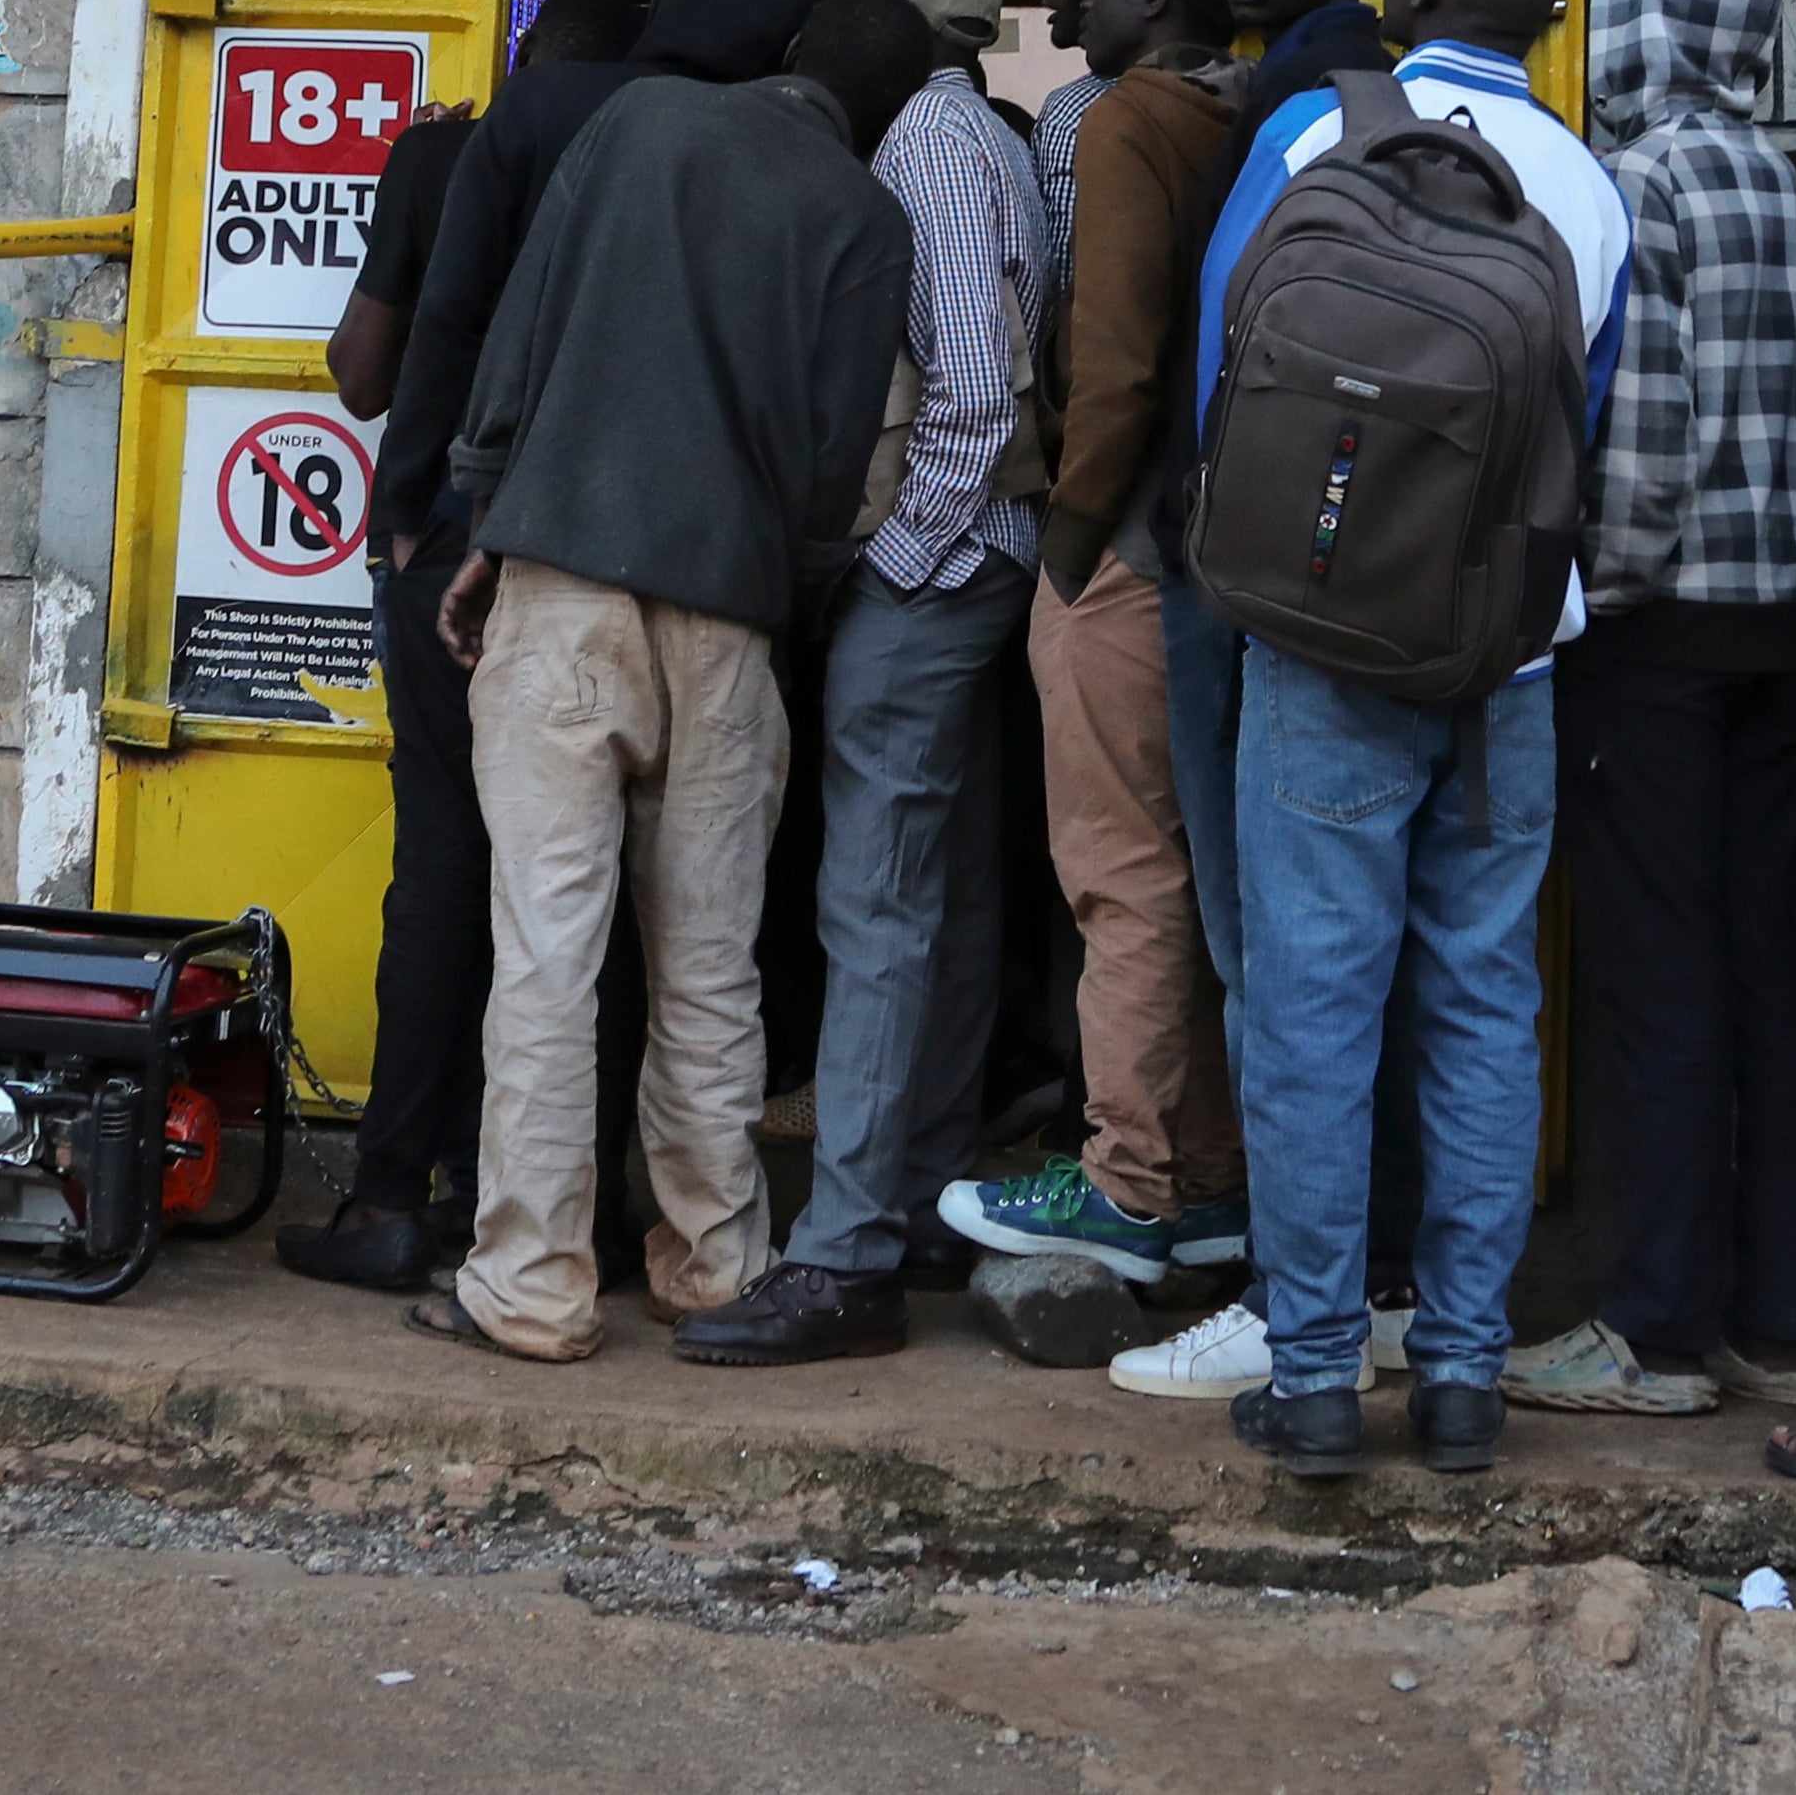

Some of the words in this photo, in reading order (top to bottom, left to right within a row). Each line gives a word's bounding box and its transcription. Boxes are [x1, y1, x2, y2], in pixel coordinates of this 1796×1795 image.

[238, 69, 399, 146] 18+
[217, 179, 376, 216] ADULT
[268, 433, 322, 449] UNDER
[251, 452, 343, 551] 18
[204, 609, 227, 622] This
[229, 611, 258, 625] Shop
[260, 613, 271, 624] Is
[271, 614, 312, 629] Strictly
[313, 617, 372, 631] Prohibited
[191, 627, 210, 639] For
[211, 629, 251, 642] Persons
[253, 631, 285, 644] Under
[286, 634, 307, 645] The
[307, 635, 330, 649] Age
[331, 637, 346, 648] Of
[186, 646, 258, 661] Management
[260, 650, 283, 663] Will
[285, 652, 306, 665] Not
[307, 653, 323, 665] Be
[325, 655, 359, 668] Liable
[195, 665, 219, 678] Any
[221, 666, 251, 680] Legal
[252, 669, 290, 682] Action
